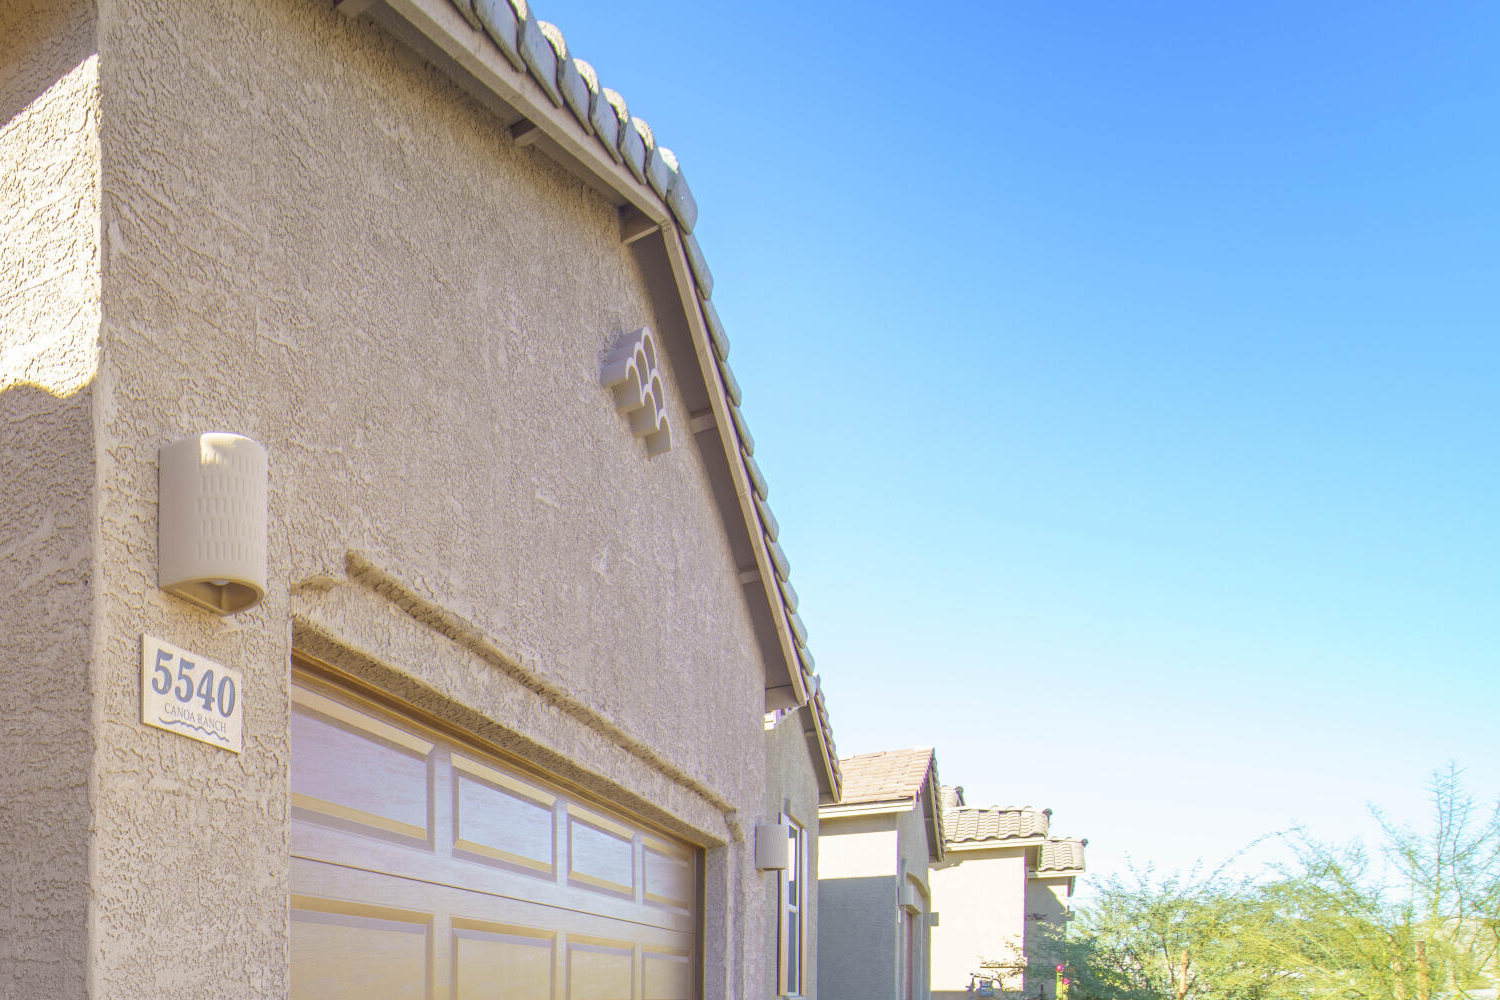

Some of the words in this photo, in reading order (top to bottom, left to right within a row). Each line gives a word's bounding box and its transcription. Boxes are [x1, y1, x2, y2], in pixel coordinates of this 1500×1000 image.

[152, 648, 235, 718] 5540
[164, 703, 195, 723] CANOA
[197, 714, 226, 733] RANCH
